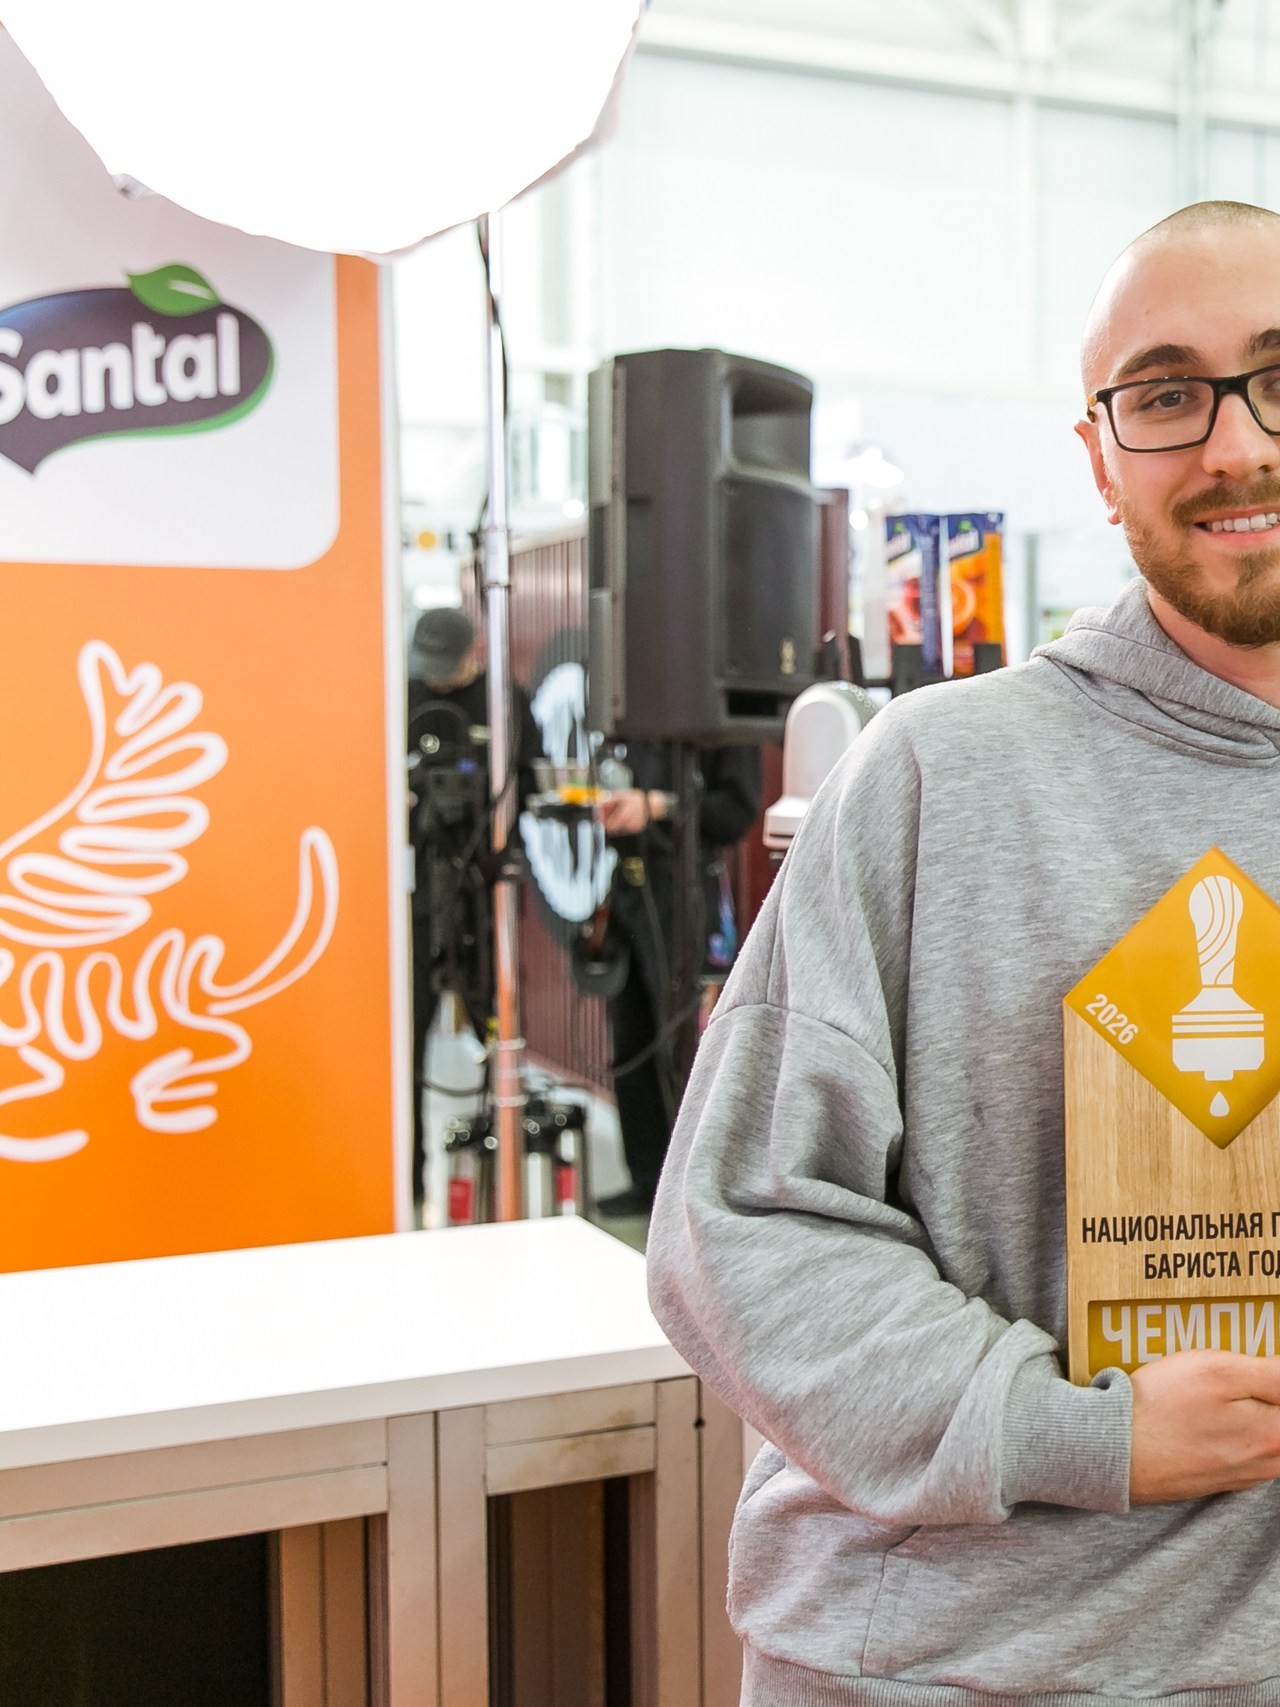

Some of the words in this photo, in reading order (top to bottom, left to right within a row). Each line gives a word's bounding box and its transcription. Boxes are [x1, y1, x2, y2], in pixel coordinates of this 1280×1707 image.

[1085, 993, 1139, 1045] 2026
[1081, 1212, 1263, 1245] НАЦИОНАЛЬНАЯ
[1144, 1251, 1241, 1279] БАРИСТА
